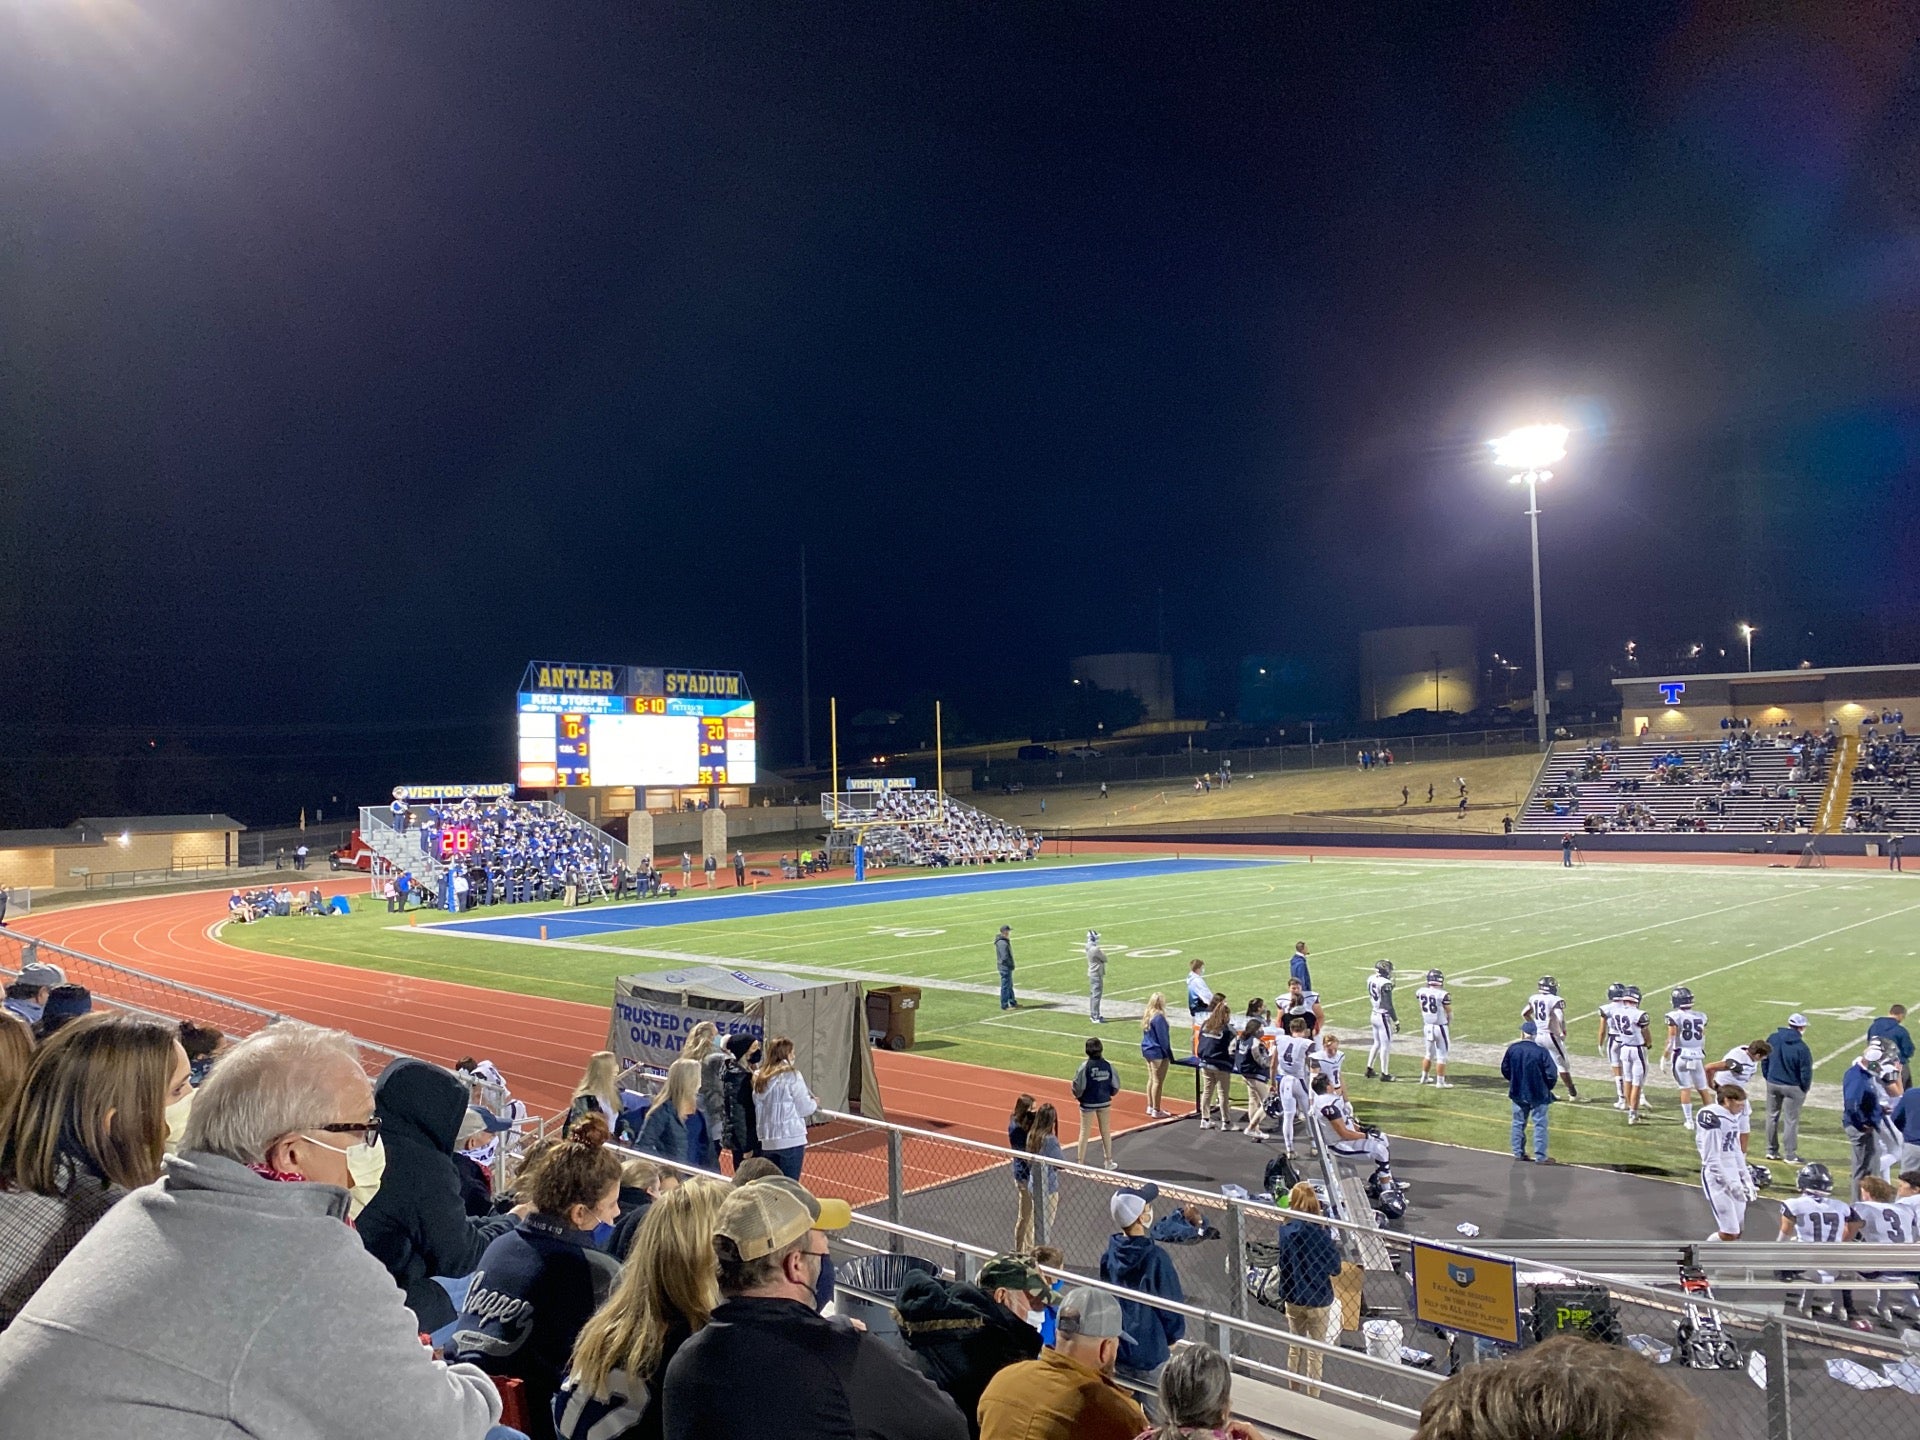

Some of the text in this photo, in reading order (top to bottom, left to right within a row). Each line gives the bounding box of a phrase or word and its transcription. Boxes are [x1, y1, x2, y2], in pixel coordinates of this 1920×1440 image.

[539, 668, 613, 690] ANTLER
[666, 674, 739, 695] STADIUM
[532, 694, 612, 706] KEN STOEPEL
[1659, 683, 1685, 704] T
[636, 697, 665, 714] 6:10
[567, 723, 578, 739] 0
[707, 725, 725, 740] 20
[578, 742, 588, 756] 3
[701, 743, 709, 756] 3
[558, 774, 567, 787] 3
[581, 774, 590, 787] 5
[699, 771, 713, 784] 35
[718, 771, 726, 784] 3
[850, 778, 912, 789] VISITOR DRILL
[408, 785, 463, 798] VISITOR
[443, 831, 468, 851] 28
[1420, 994, 1439, 1014] 28
[1534, 999, 1547, 1021] 13
[616, 1003, 765, 1042] TRUSTED CE FOR
[1614, 1014, 1634, 1036] 12
[1682, 1019, 1704, 1041] 85
[631, 1027, 661, 1049] OUR
[1282, 1043, 1293, 1066] 4
[1702, 1112, 1713, 1123] 15
[1809, 1212, 1839, 1242] 17
[1882, 1209, 1905, 1243] 3
